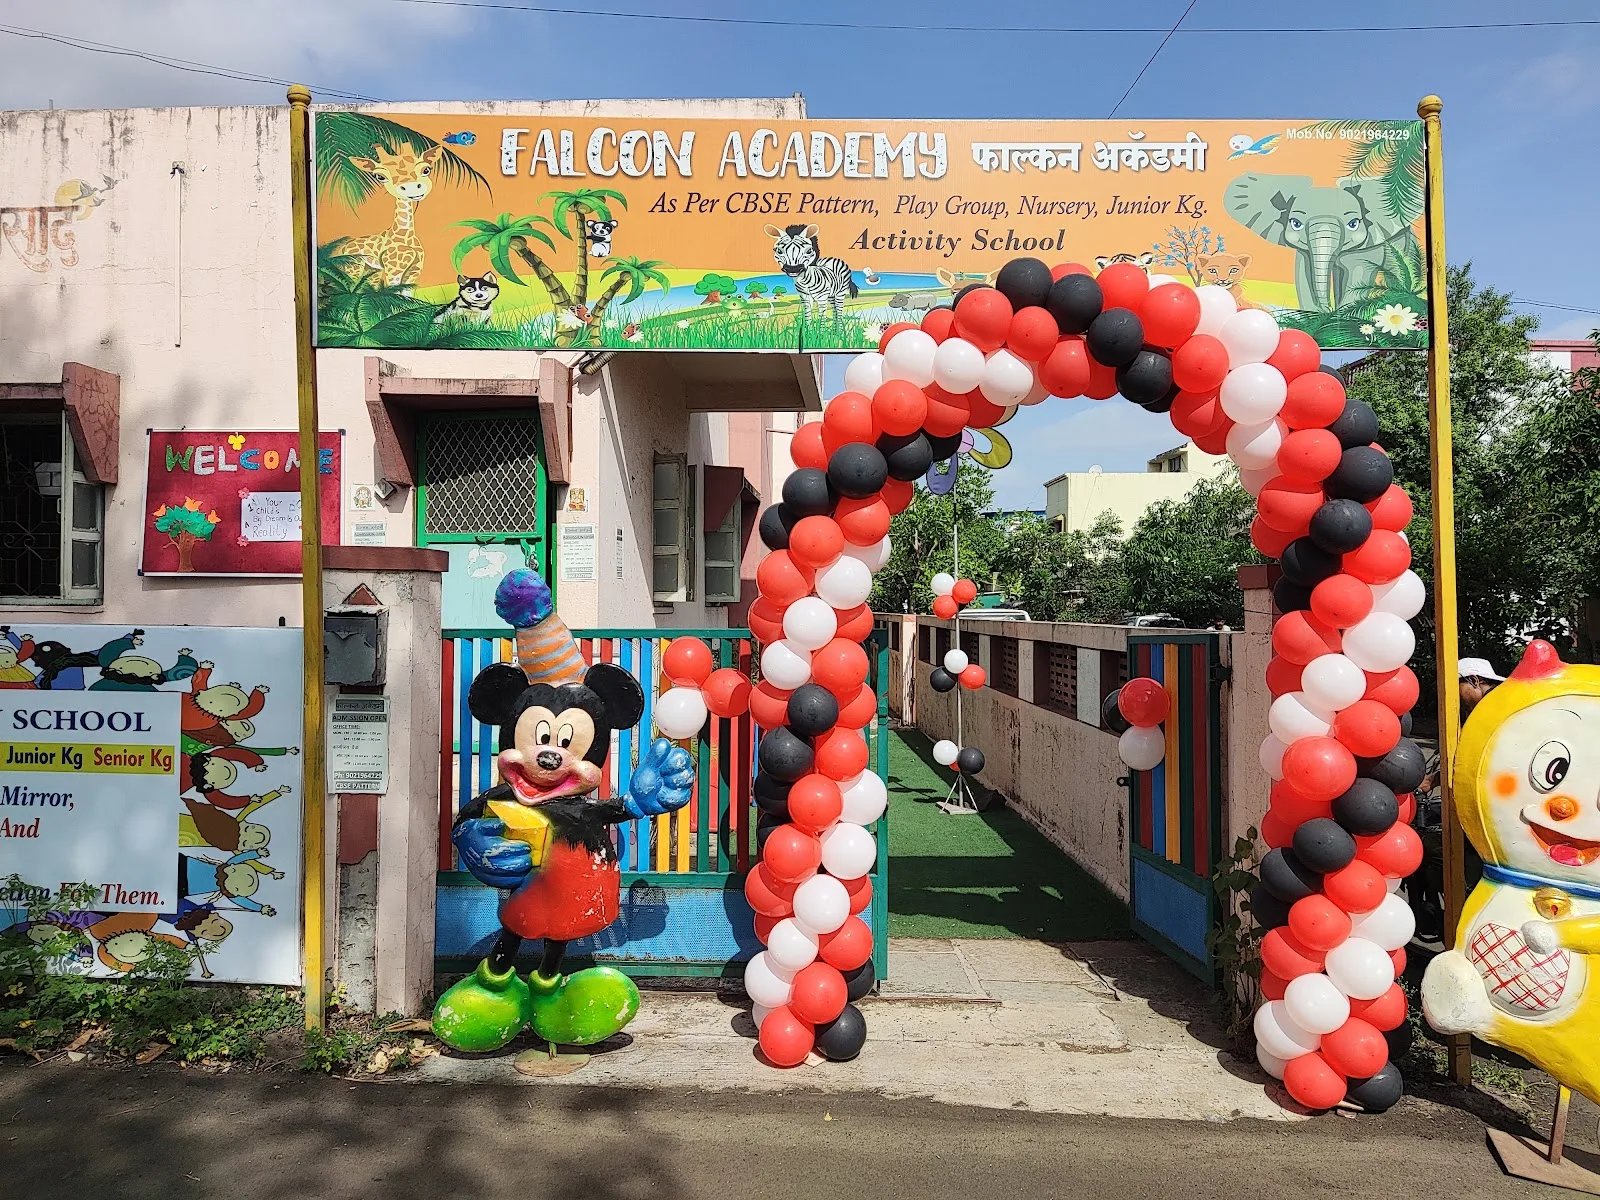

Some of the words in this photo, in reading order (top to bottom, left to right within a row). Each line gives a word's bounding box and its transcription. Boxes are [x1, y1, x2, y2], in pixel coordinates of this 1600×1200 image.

[1339, 129, 1410, 141] 9021964229
[500, 128, 695, 177] FALCON
[718, 129, 948, 179] ACADEMY
[971, 140, 1082, 173] फाल्कन
[648, 193, 681, 215] As
[684, 193, 720, 215] Per
[725, 192, 793, 215] CBSE
[796, 193, 880, 217] Pattern,
[894, 195, 939, 219] Play
[945, 196, 1010, 219] Group,
[1016, 196, 1099, 219] Nursery,
[1105, 195, 1174, 217] Junior
[1175, 196, 1209, 219] Kg.
[849, 228, 962, 256] Activity
[970, 229, 1065, 252] School
[12, 709, 152, 733] SCHOOL
[6, 746, 56, 766] Junior
[61, 747, 83, 770] Kg
[93, 747, 145, 767] Senior
[150, 749, 172, 772] Kg
[0, 785, 75, 812] Mirror,
[0, 817, 41, 838] And
[100, 883, 165, 905] Them.
